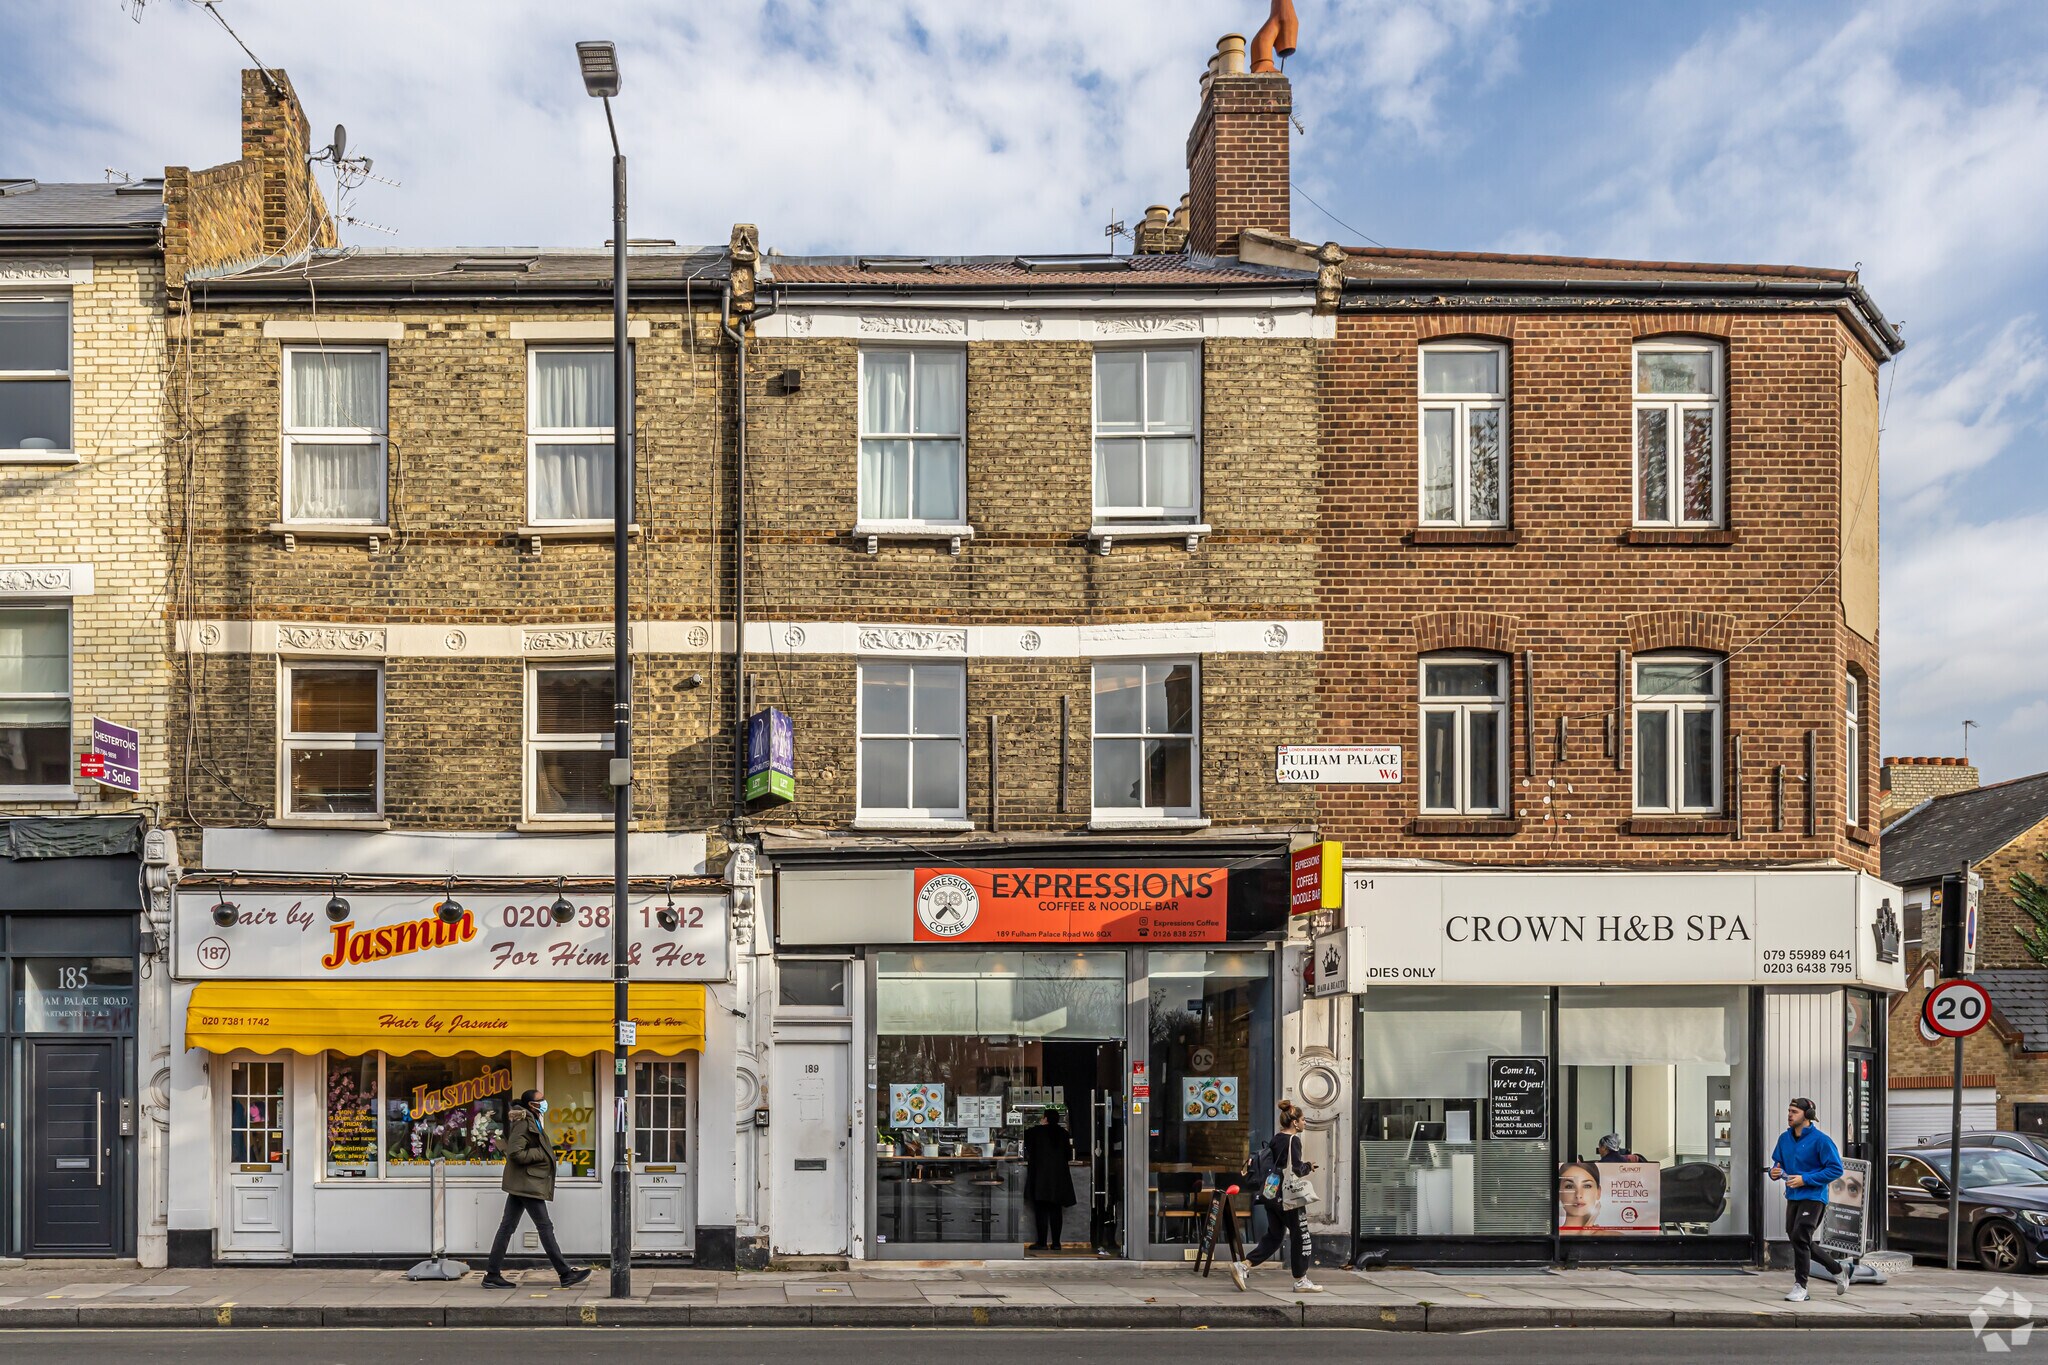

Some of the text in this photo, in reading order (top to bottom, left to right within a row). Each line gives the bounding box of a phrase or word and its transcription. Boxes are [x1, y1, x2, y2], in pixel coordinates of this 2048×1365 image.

[94, 730, 136, 751] CHESTERTONS
[1282, 754, 1398, 765] FULHAM PALACE
[112, 769, 131, 785] Sale
[1379, 769, 1398, 779] W6
[1294, 855, 1320, 871] EXPRESSIONS
[992, 873, 1213, 899] EXPRESSIONS
[1296, 872, 1318, 888] COFFEE &
[1353, 880, 1375, 890] 191
[921, 877, 975, 902] EXPRESSIONS
[1292, 888, 1322, 905] NOODLE BAR
[1038, 901, 1178, 911] COFFEE & NOODLE BAR
[211, 901, 315, 931] air by
[503, 905, 562, 928] 020
[578, 906, 611, 928] 38
[929, 920, 967, 933] COFFEE
[1153, 920, 1196, 928] Expressions
[1446, 914, 1751, 942] CROWN H&B SPA
[321, 902, 478, 970] Jasmin
[202, 946, 227, 960] 187
[490, 941, 706, 970] For Him & Her
[1763, 950, 1851, 960] 079 55989 641
[1365, 967, 1436, 978] DIES ONLY
[1763, 963, 1852, 973] 0203 6438 795
[58, 966, 88, 989] 185
[1317, 982, 1327, 993] HAIR
[1329, 979, 1345, 991] BEAUTY
[64, 996, 98, 1006] PALACE
[103, 996, 128, 1006] ROAD
[1937, 996, 1982, 1019] 20
[202, 1017, 270, 1026] 020 7381 1742
[378, 1014, 509, 1033] Hair by Jasmin
[653, 1017, 661, 1026] &
[664, 1017, 682, 1026] Her
[804, 1064, 820, 1073] 189
[1500, 1065, 1537, 1076] Come In,
[410, 1064, 513, 1120] Jasmin
[1493, 1080, 1544, 1092] We're Open!
[549, 1107, 594, 1124] 0207
[553, 1128, 587, 1145] 381
[1918, 1137, 1928, 1145] NO
[408, 1158, 430, 1166] Fulha
[445, 1158, 467, 1166] alace
[486, 1158, 507, 1166] Lond
[553, 1149, 591, 1165] 742
[252, 1176, 264, 1184] 187
[1611, 1180, 1643, 1188] HYDRA
[1611, 1189, 1649, 1198] PEELING
